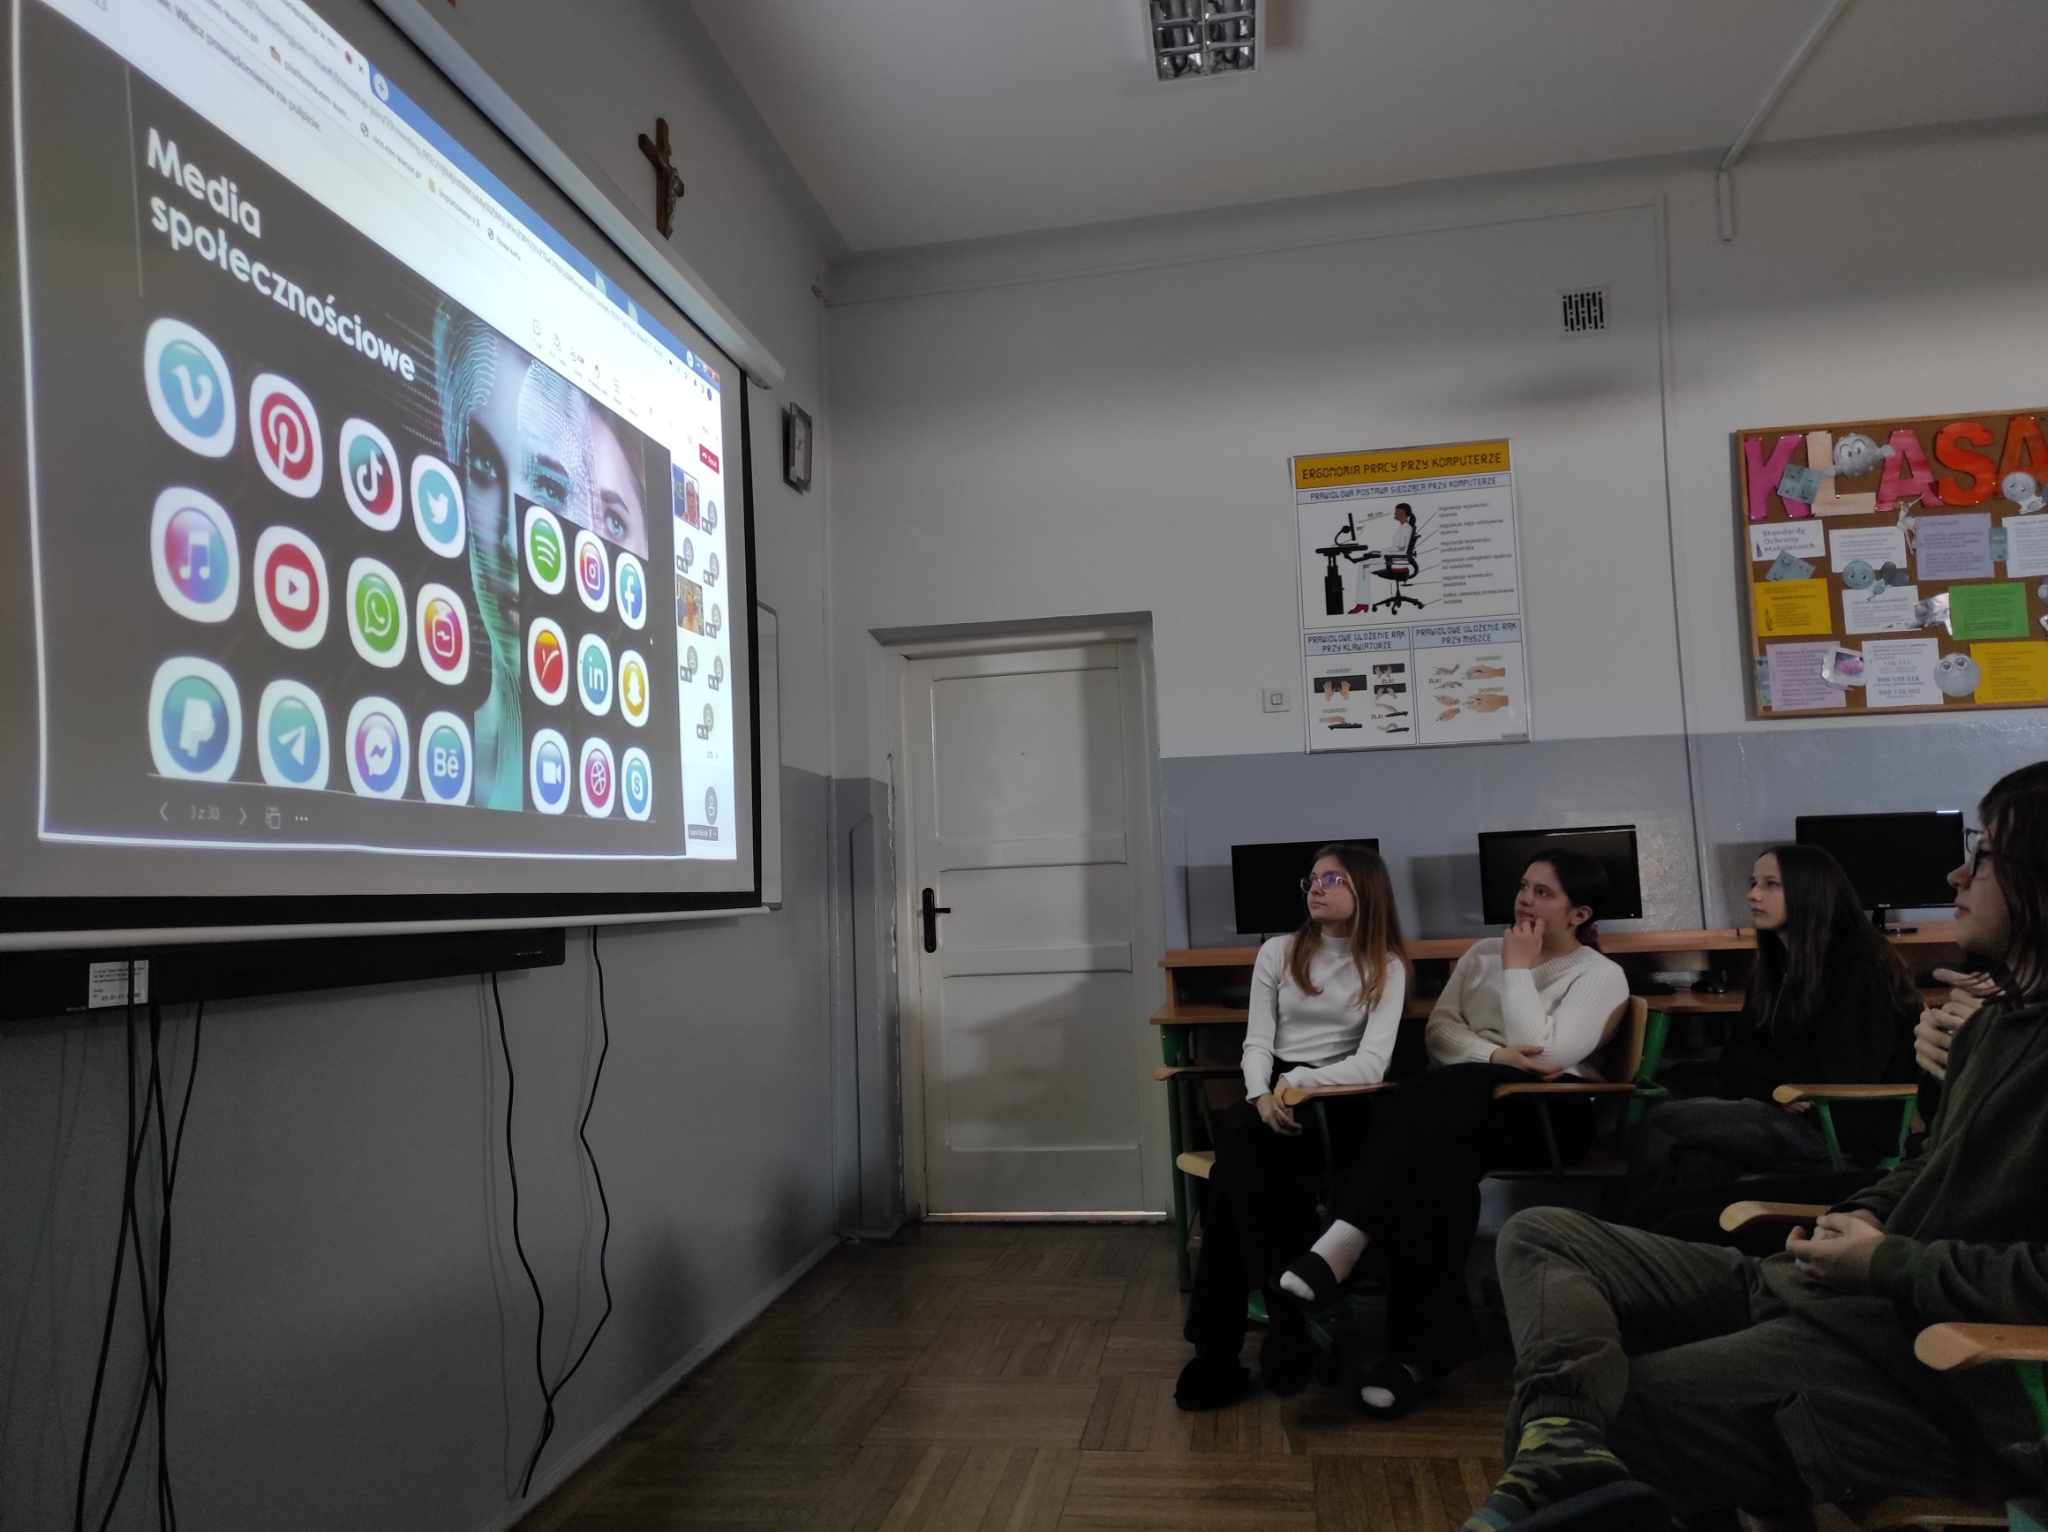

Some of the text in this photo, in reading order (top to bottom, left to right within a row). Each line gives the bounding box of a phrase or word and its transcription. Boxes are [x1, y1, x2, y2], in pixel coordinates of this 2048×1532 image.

[147, 127, 262, 239] Media
[150, 196, 416, 381] społecznościowe
[1302, 452, 1501, 480] ERGONOMIA PRACY PRZY KOMPUTERZE
[1428, 481, 1447, 490] PRZY
[1449, 477, 1496, 488] KOMPUTERZE
[1744, 413, 2048, 521] KLASA
